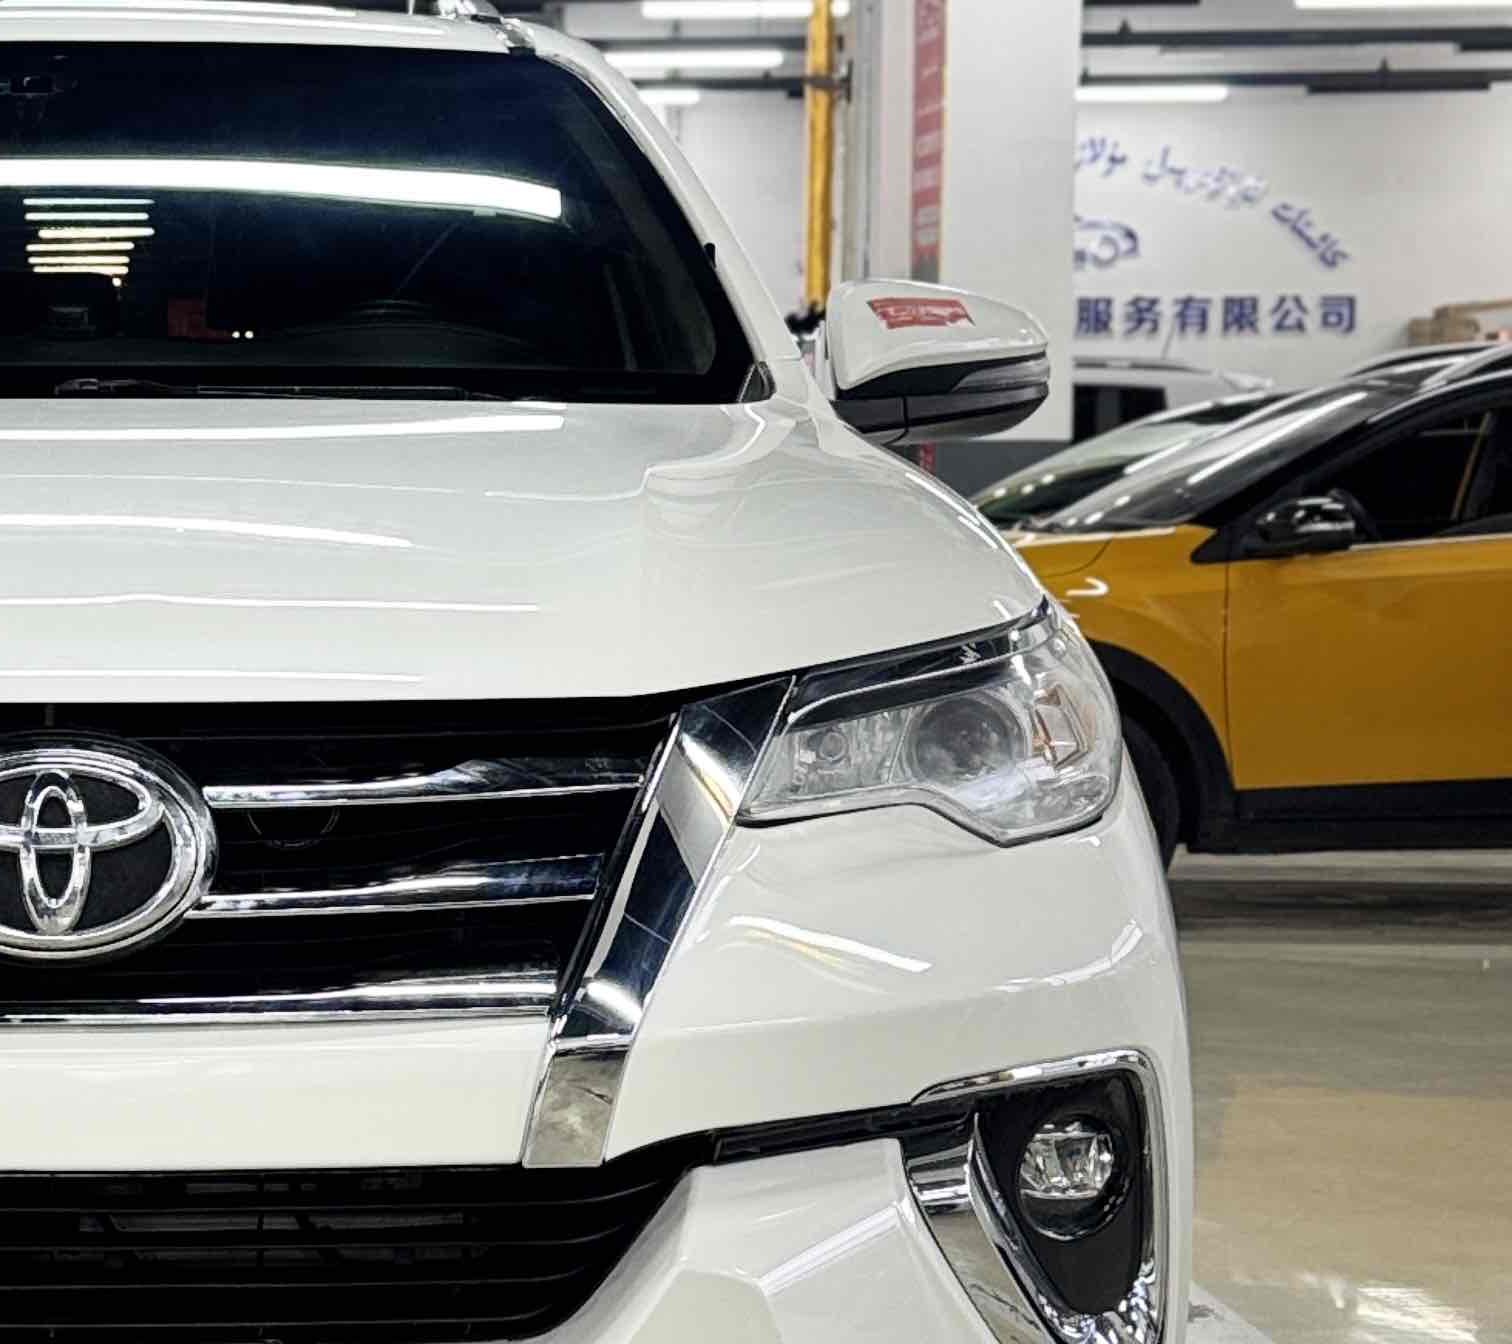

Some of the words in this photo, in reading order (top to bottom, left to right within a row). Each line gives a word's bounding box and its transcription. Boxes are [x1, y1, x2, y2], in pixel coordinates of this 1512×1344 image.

[1074, 295, 1357, 337] 服务有限公司
